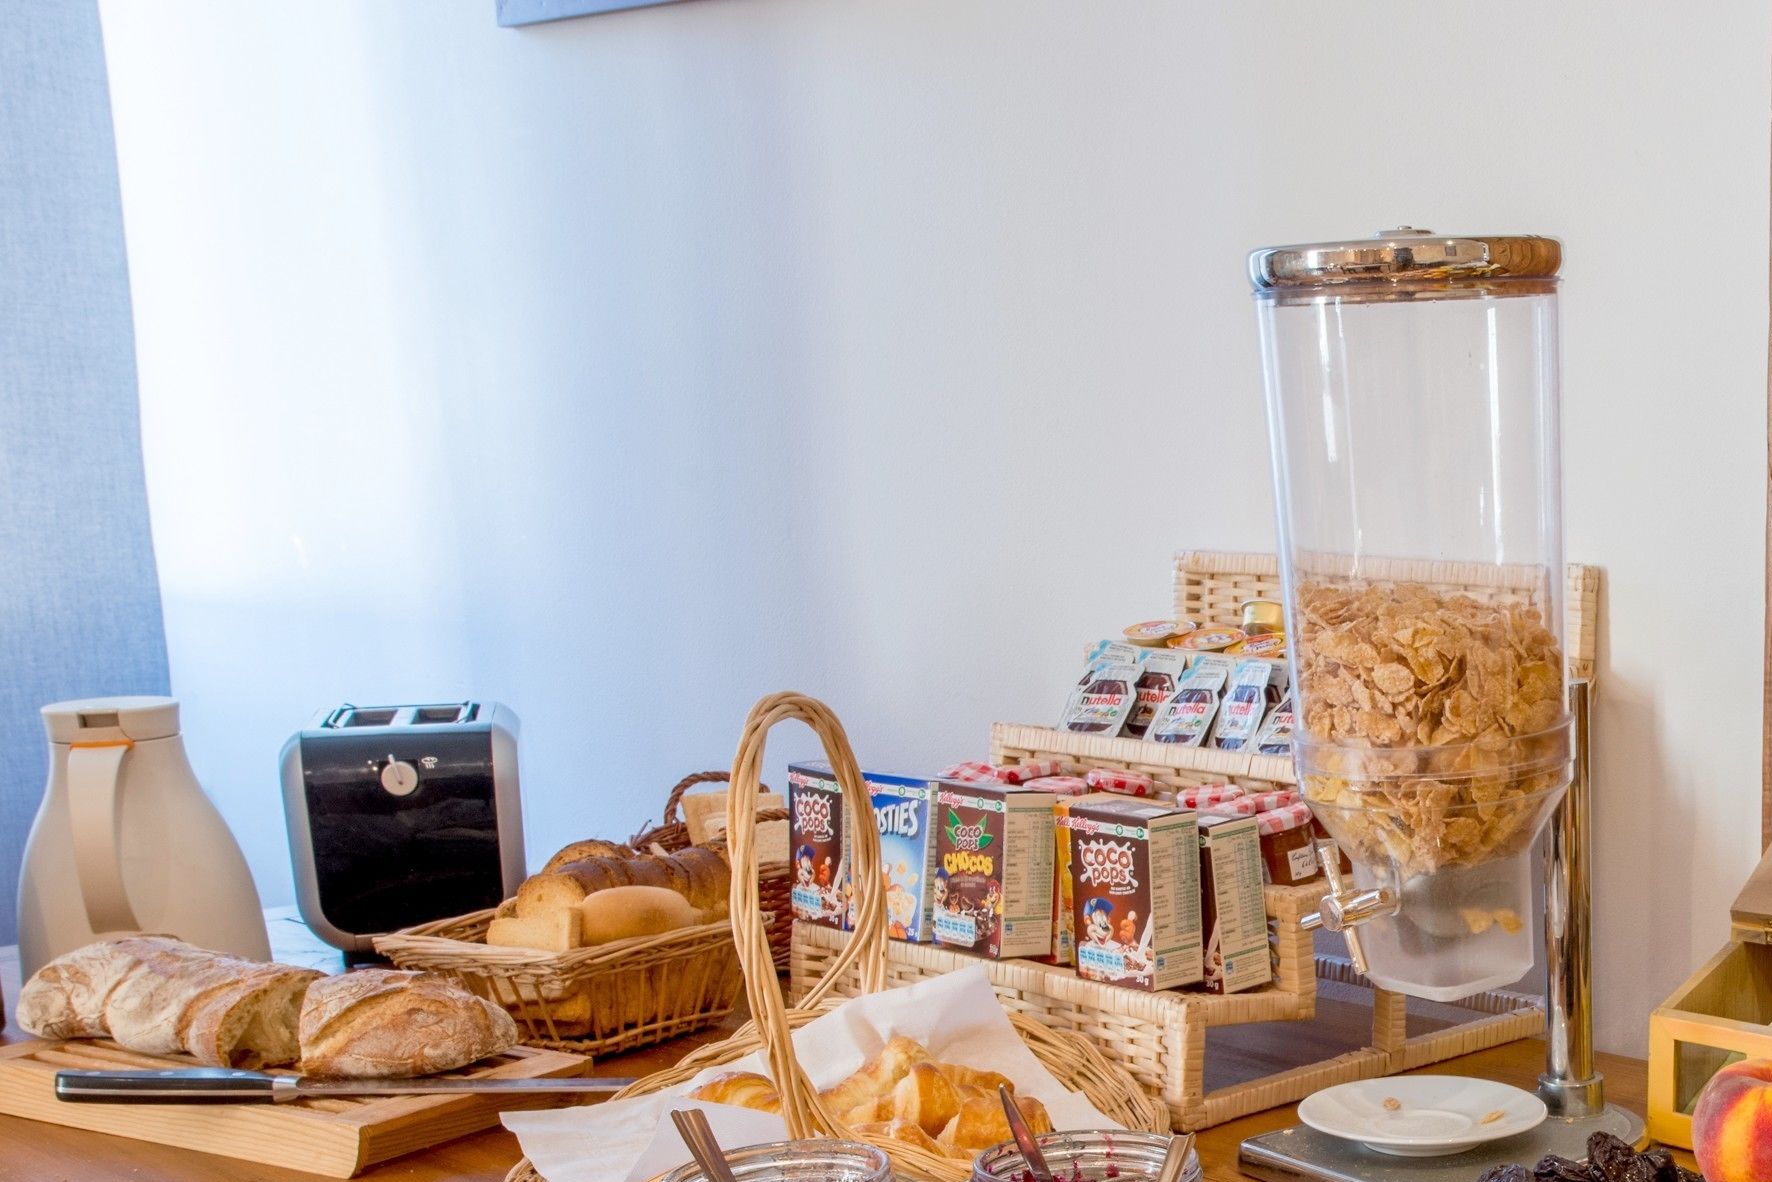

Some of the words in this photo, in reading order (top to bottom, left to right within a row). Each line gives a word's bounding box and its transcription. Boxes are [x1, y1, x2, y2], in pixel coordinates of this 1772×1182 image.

[1081, 694, 1121, 706] nutella
[1169, 702, 1207, 716] nutella
[874, 801, 919, 837] OSTIES
[954, 825, 981, 838] COCO
[1082, 846, 1132, 868] COCO
